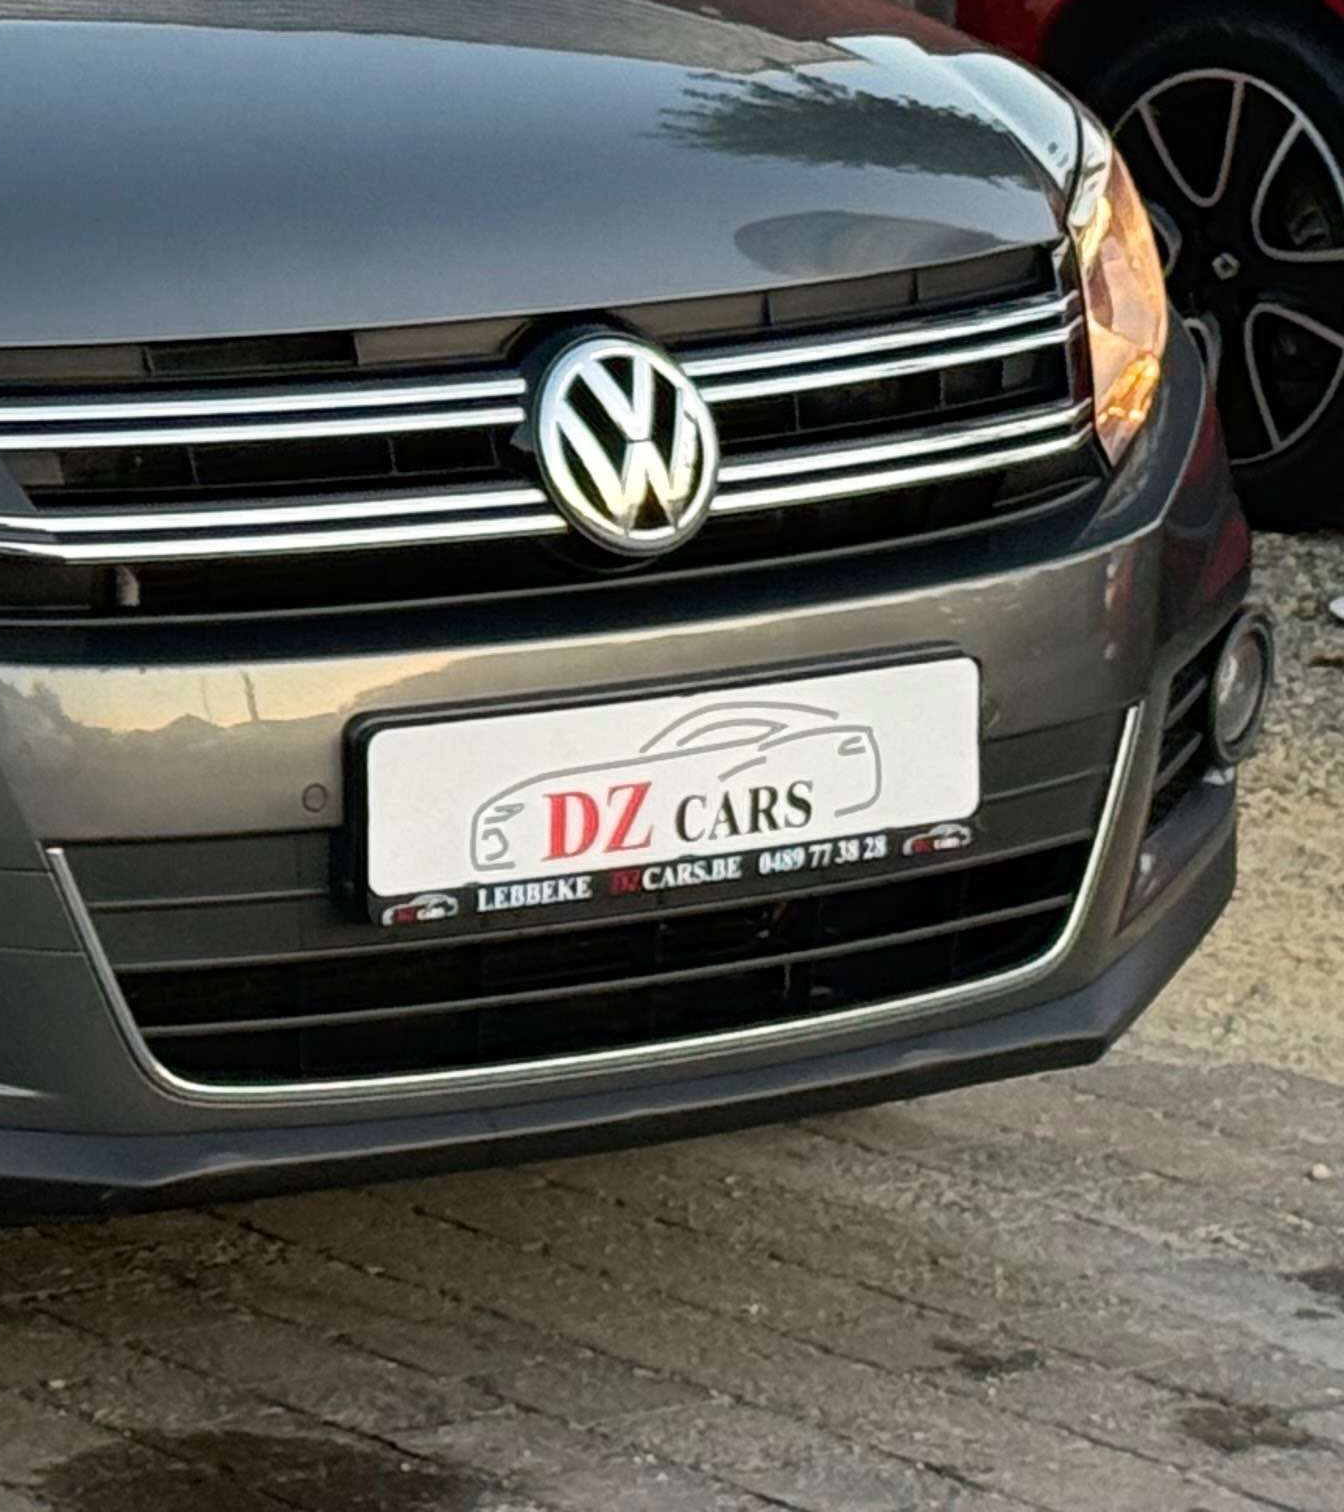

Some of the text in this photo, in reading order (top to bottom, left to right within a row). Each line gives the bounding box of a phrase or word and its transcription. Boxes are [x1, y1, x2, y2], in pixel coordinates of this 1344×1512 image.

[548, 348, 704, 538] VW
[543, 779, 814, 861] DZ CARS
[476, 874, 593, 913] LEBBEKE
[758, 846, 806, 875] 0489
[808, 842, 833, 868] 77
[834, 838, 860, 864] 38
[863, 834, 887, 860] 28
